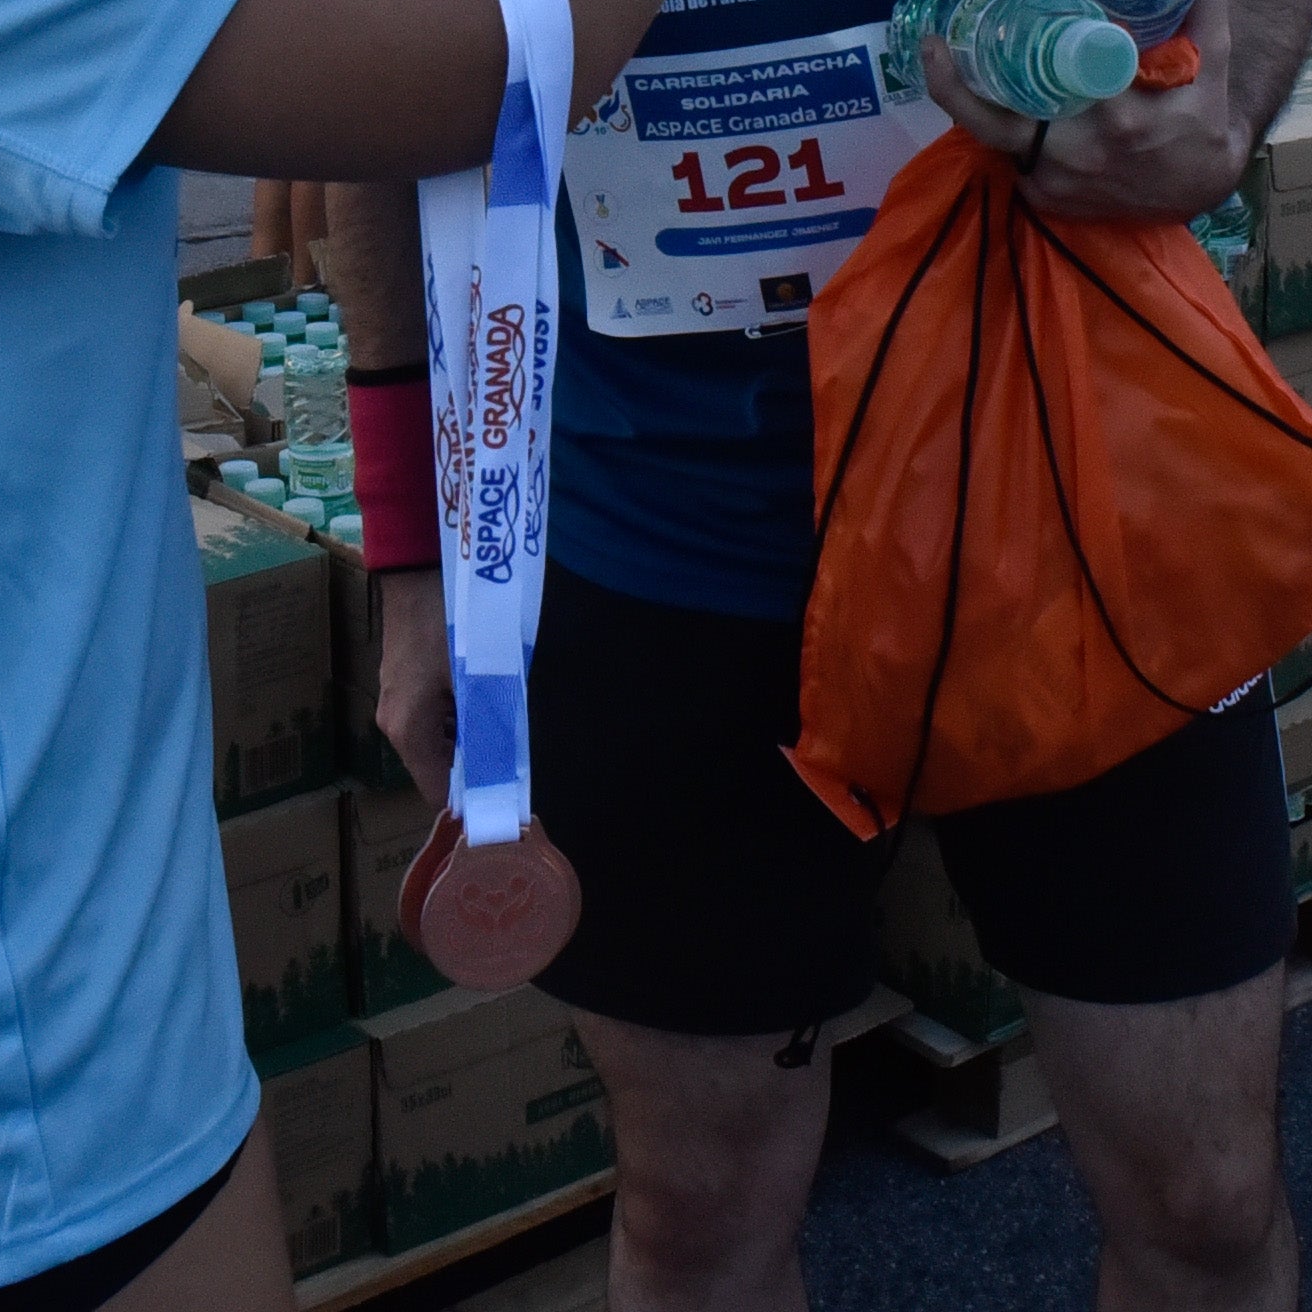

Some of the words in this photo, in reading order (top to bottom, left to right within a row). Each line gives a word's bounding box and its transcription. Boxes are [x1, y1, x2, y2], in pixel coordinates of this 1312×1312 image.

[634, 52, 862, 92] CARRERA-MARCHA
[679, 83, 810, 112] SOLIDARIA
[644, 118, 723, 138] ASPACE
[729, 107, 818, 132] Granada
[822, 96, 874, 121] 2025
[671, 137, 846, 213] 121
[482, 303, 525, 451] GRANADA
[475, 467, 513, 584] ASPACE
